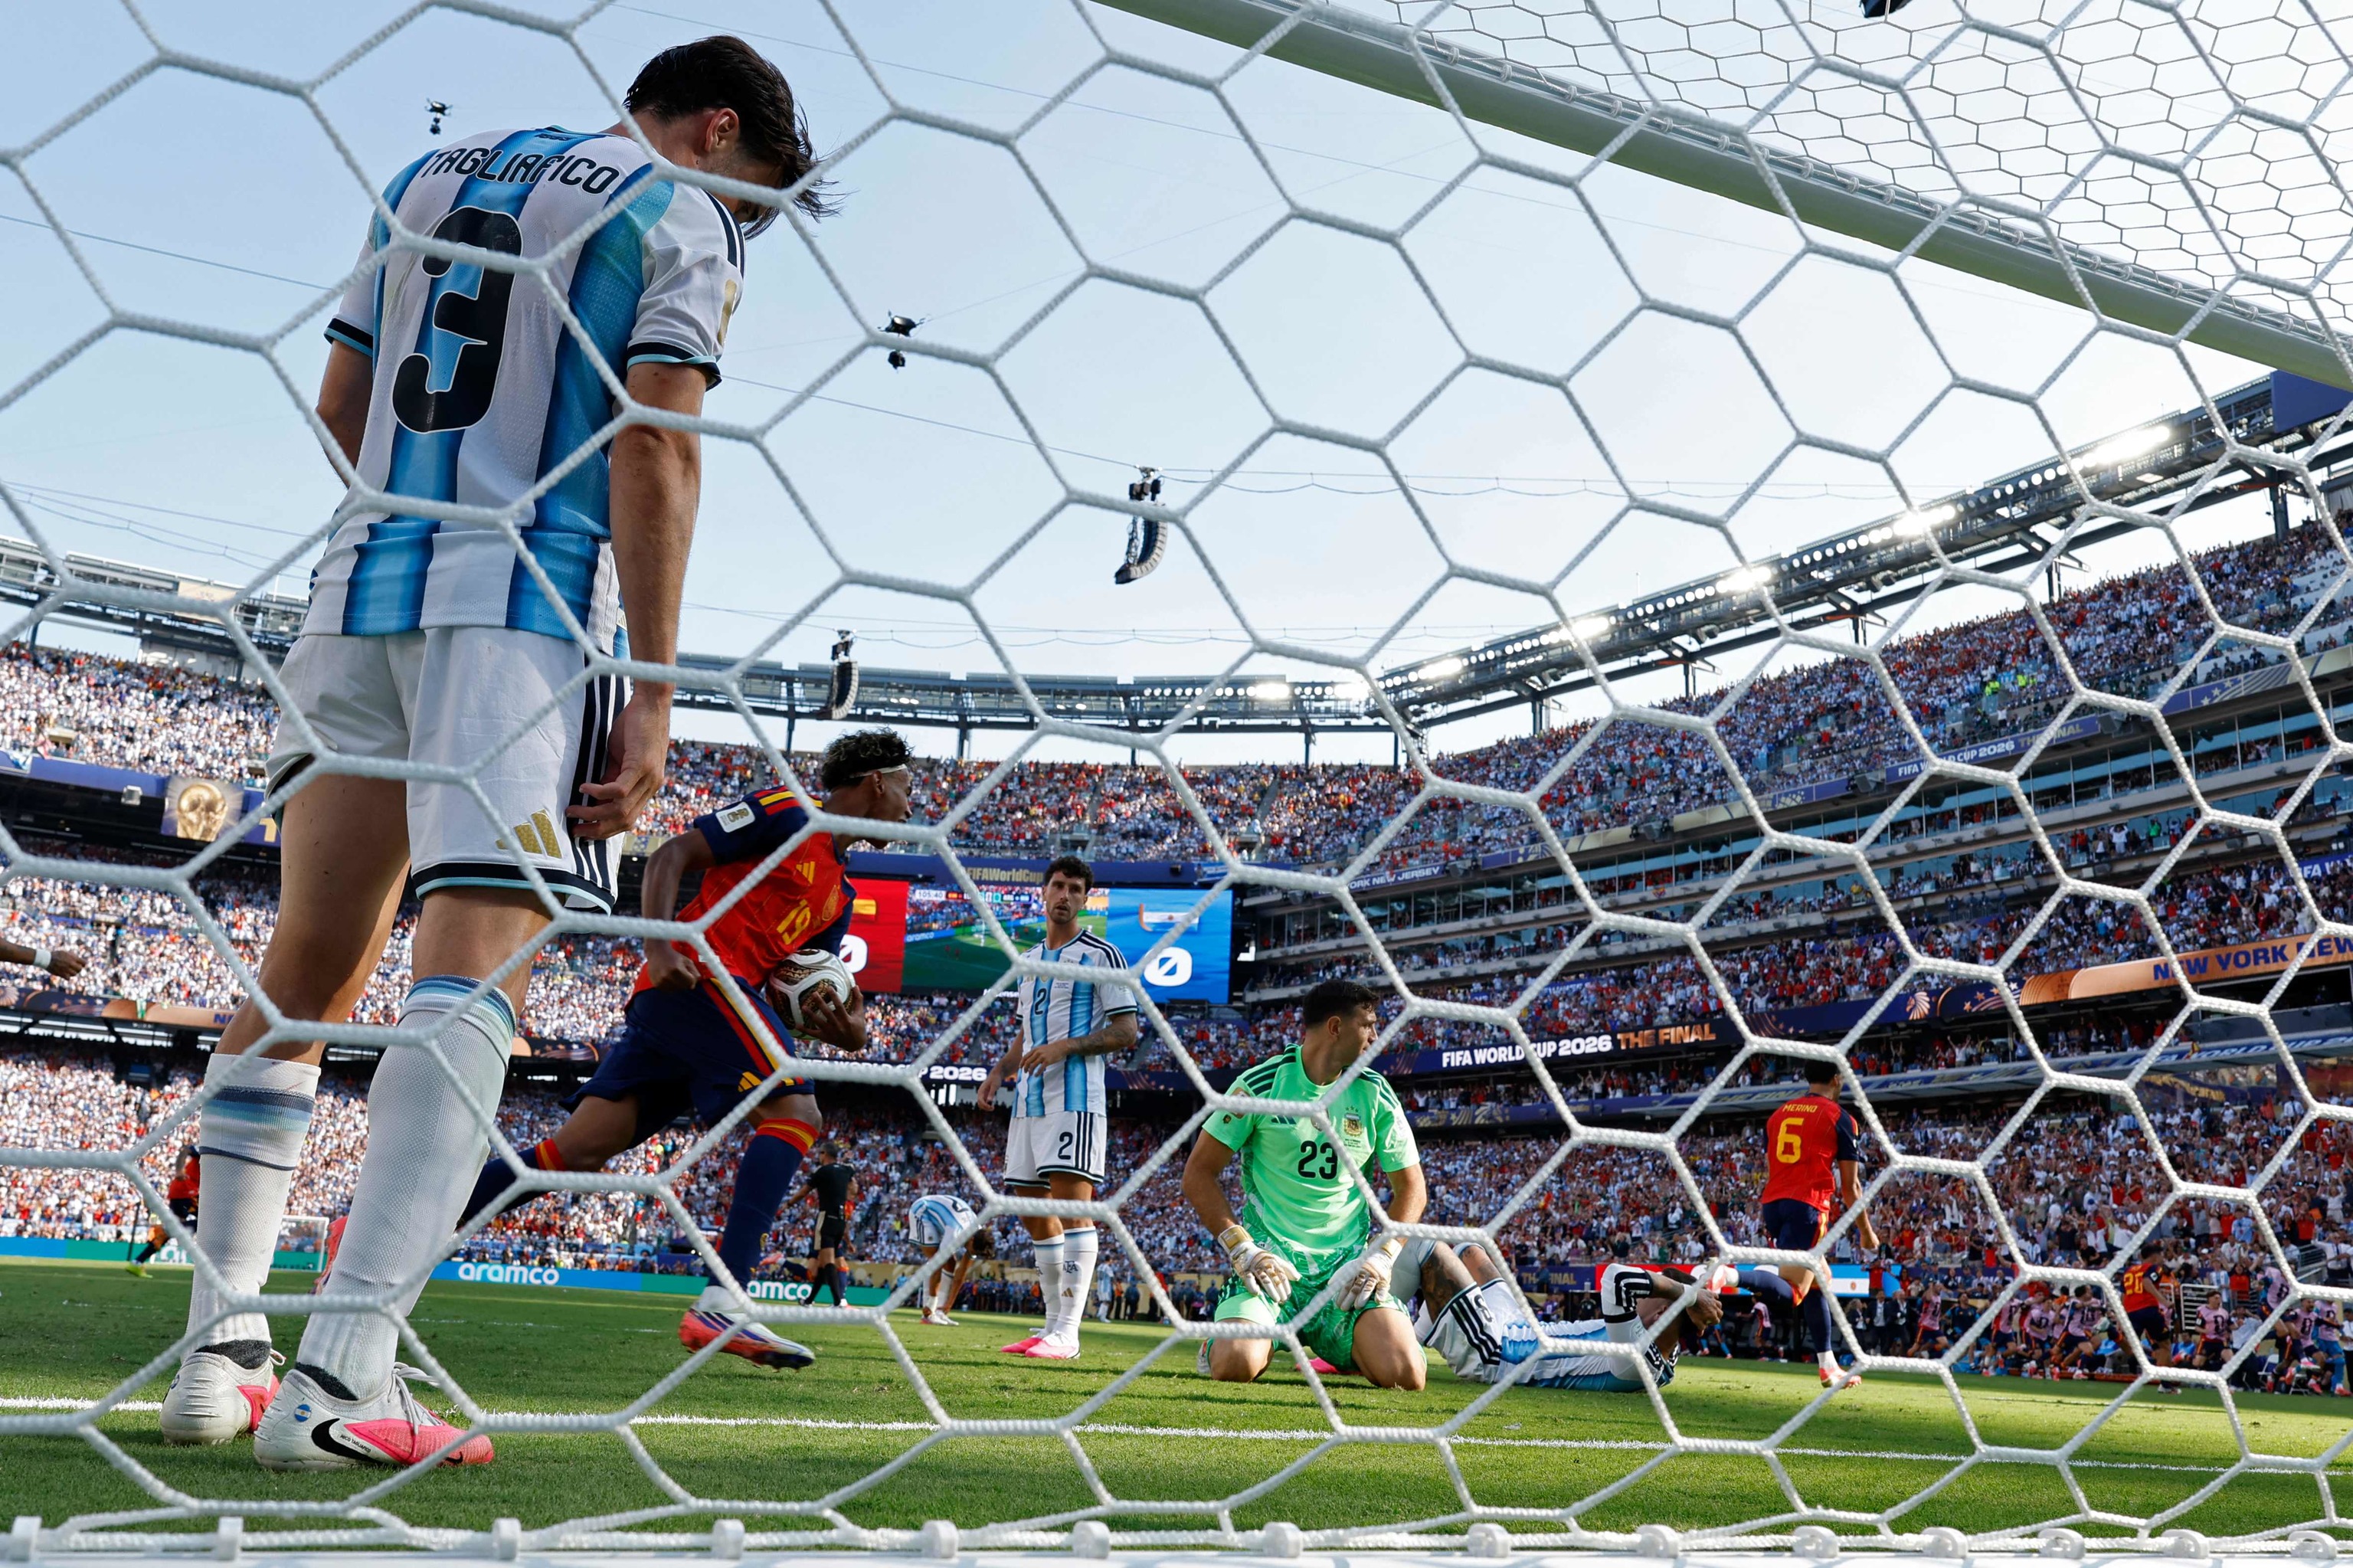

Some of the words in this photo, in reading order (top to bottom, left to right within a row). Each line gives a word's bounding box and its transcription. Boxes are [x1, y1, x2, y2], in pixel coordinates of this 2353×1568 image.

[421, 148, 620, 195] TAGLIAFICO
[392, 206, 522, 434] 3
[1898, 762, 1919, 777] FIFA
[1957, 751, 1978, 762] CUP
[1978, 740, 2015, 758] 2026
[1397, 866, 1440, 882] JERSEY
[777, 899, 811, 945] 19
[1144, 947, 1193, 987] 0
[2216, 944, 2289, 971] YORK
[1035, 987, 1048, 1016] 2
[1442, 1049, 1473, 1068] FIFA
[1474, 1044, 1525, 1065] WORLD
[1558, 1034, 1612, 1056] 2026
[1617, 1030, 1656, 1050] THE
[1658, 1023, 1716, 1046] FINAL
[929, 1066, 987, 1081] 2026
[1782, 1104, 1818, 1113] MERINO
[1058, 1131, 1073, 1160] 2
[1776, 1117, 1805, 1164] 6
[1298, 1140, 1338, 1180] 23
[458, 1263, 559, 1285] aramco
[1549, 1272, 1576, 1285] INAL
[747, 1280, 812, 1300] amco
